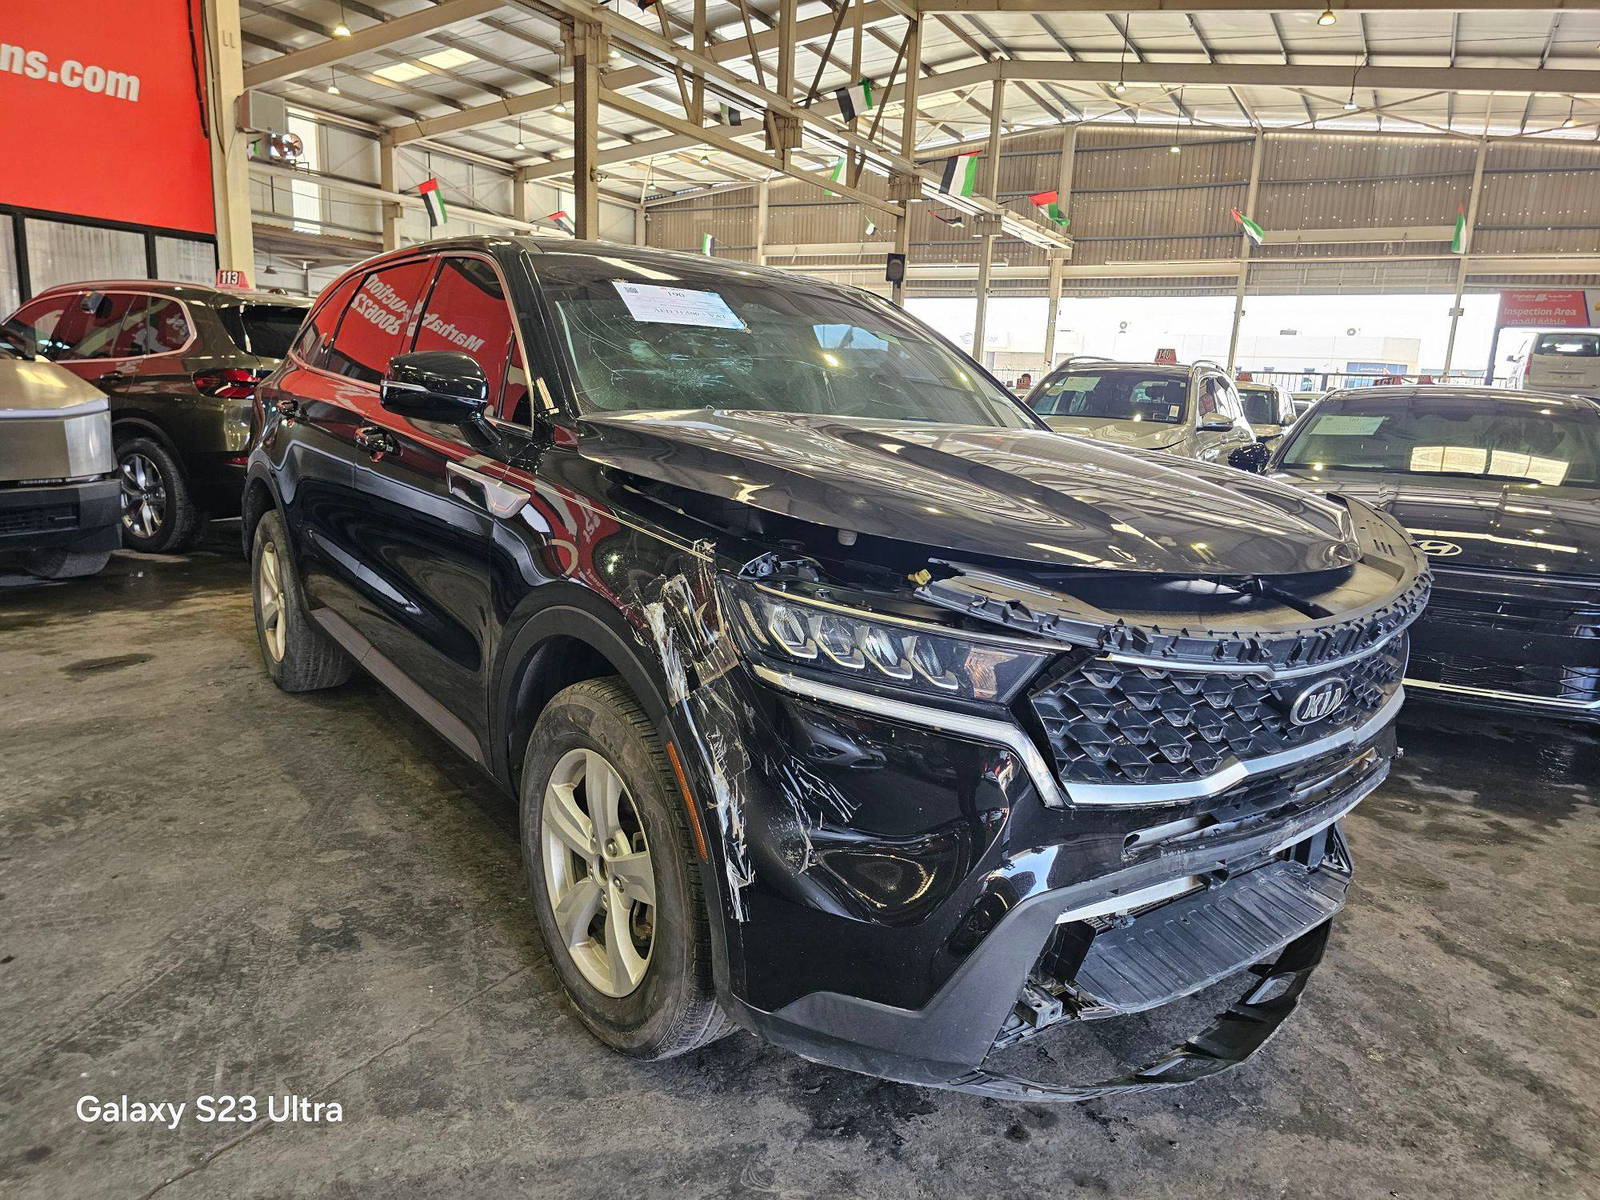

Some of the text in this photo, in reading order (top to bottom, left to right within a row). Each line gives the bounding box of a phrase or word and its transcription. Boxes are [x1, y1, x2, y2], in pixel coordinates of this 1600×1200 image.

[0, 43, 140, 102] ns.com
[221, 271, 239, 285] 113
[1503, 307, 1577, 316] Inspection Area
[1301, 687, 1342, 720] KIA
